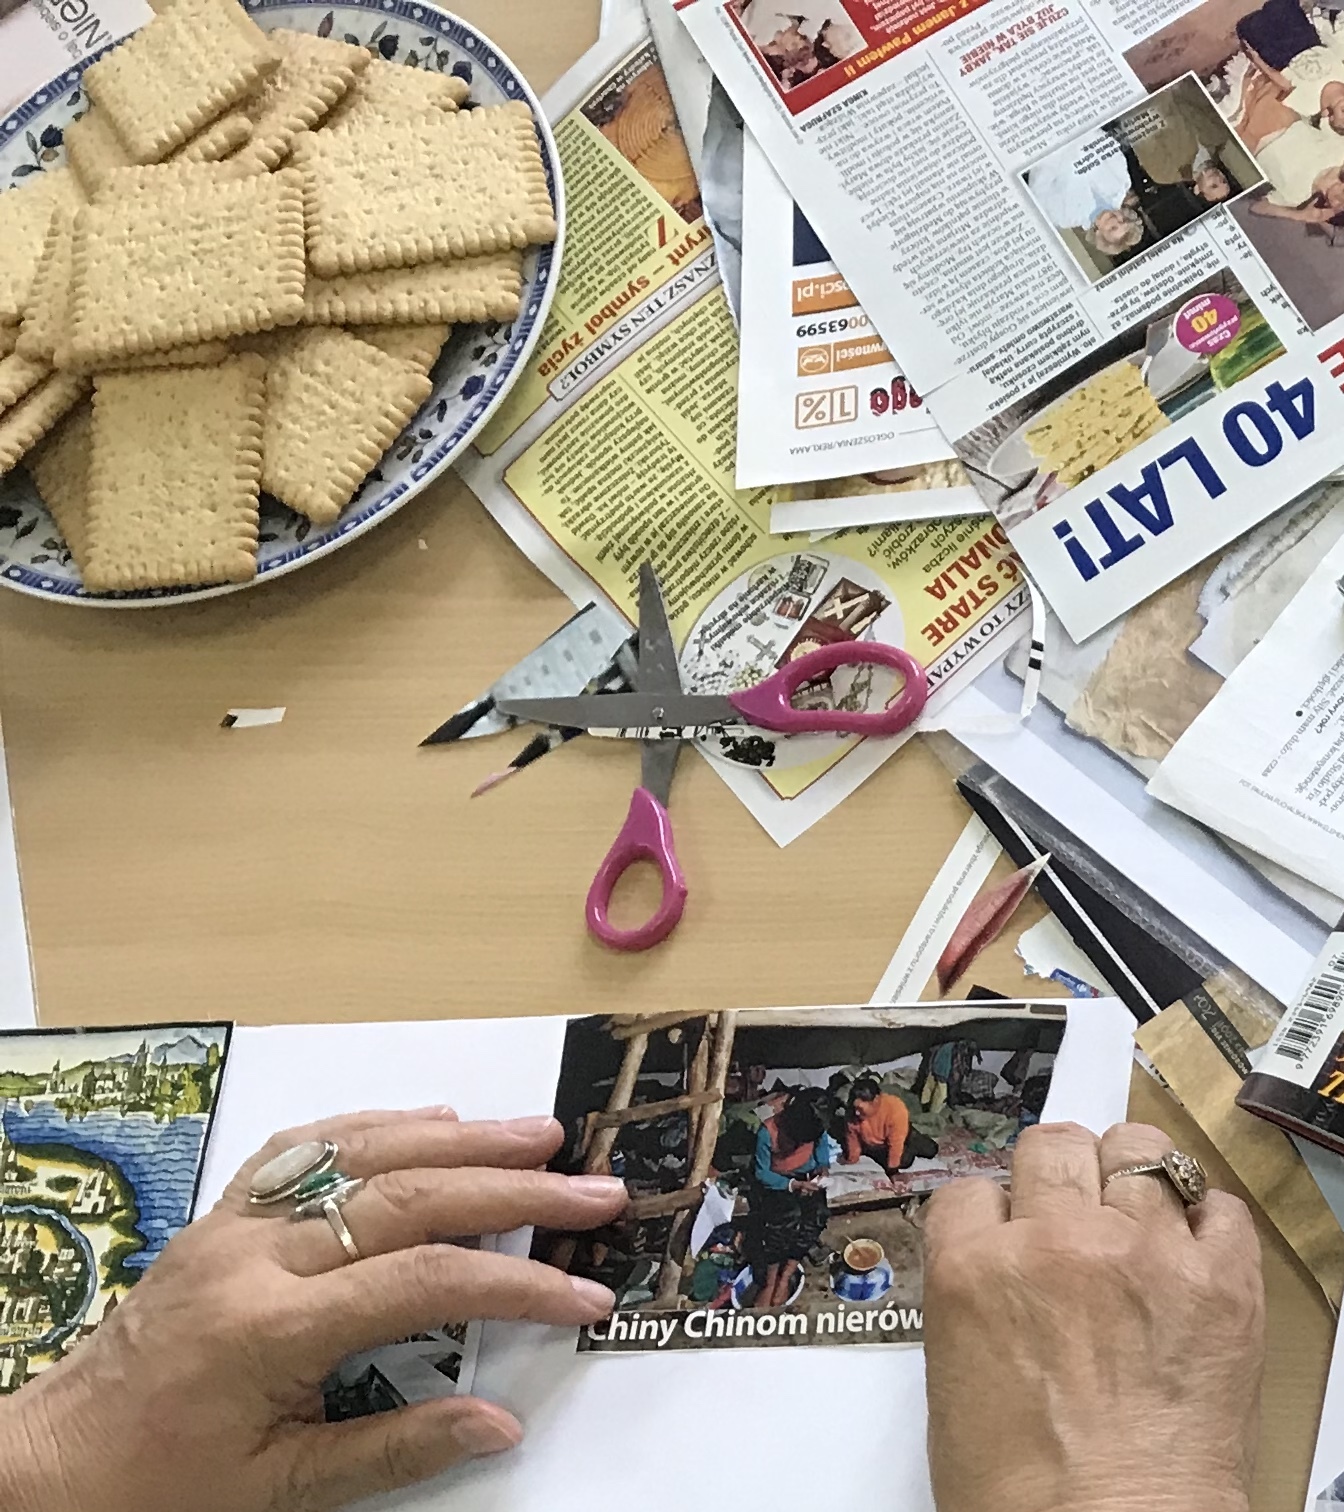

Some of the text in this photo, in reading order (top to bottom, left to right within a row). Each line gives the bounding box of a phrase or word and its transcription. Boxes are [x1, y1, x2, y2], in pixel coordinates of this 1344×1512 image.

[956, 5, 1070, 77] CZUJE JAKBY
[958, 38, 995, 65] NIEBIE
[529, 274, 657, 379] symbol życia
[628, 297, 665, 327] TEN
[1188, 305, 1223, 335] 40
[549, 322, 639, 390] SYMBOL?
[1222, 375, 1316, 468] 40
[1051, 449, 1227, 581] LAT!
[911, 572, 1008, 648] STARE
[977, 614, 1006, 638] TO
[683, 1306, 808, 1339] Chinom
